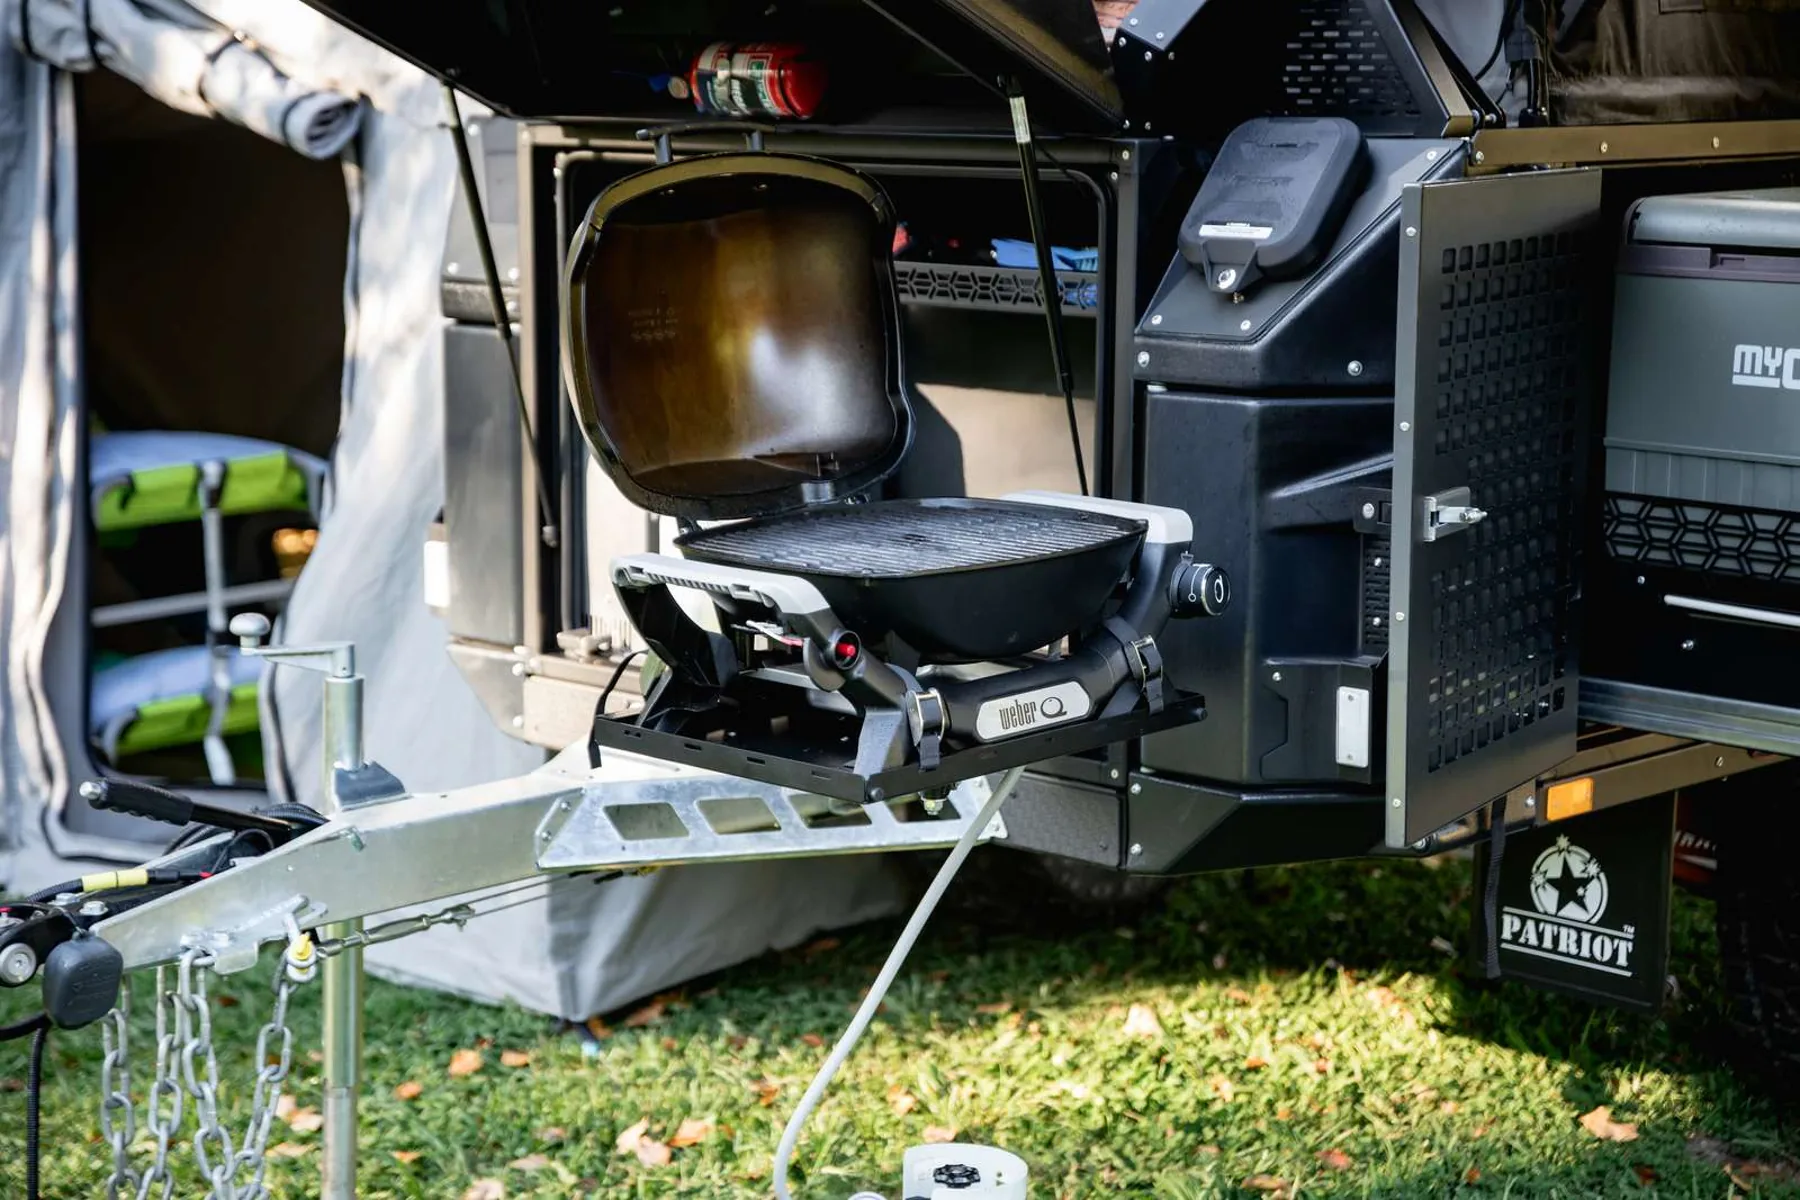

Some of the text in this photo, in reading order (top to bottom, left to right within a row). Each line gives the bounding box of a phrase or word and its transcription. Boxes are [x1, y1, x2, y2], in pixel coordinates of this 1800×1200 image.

[999, 696, 1067, 730] weber Q
[1501, 914, 1633, 967] PATRIOT
